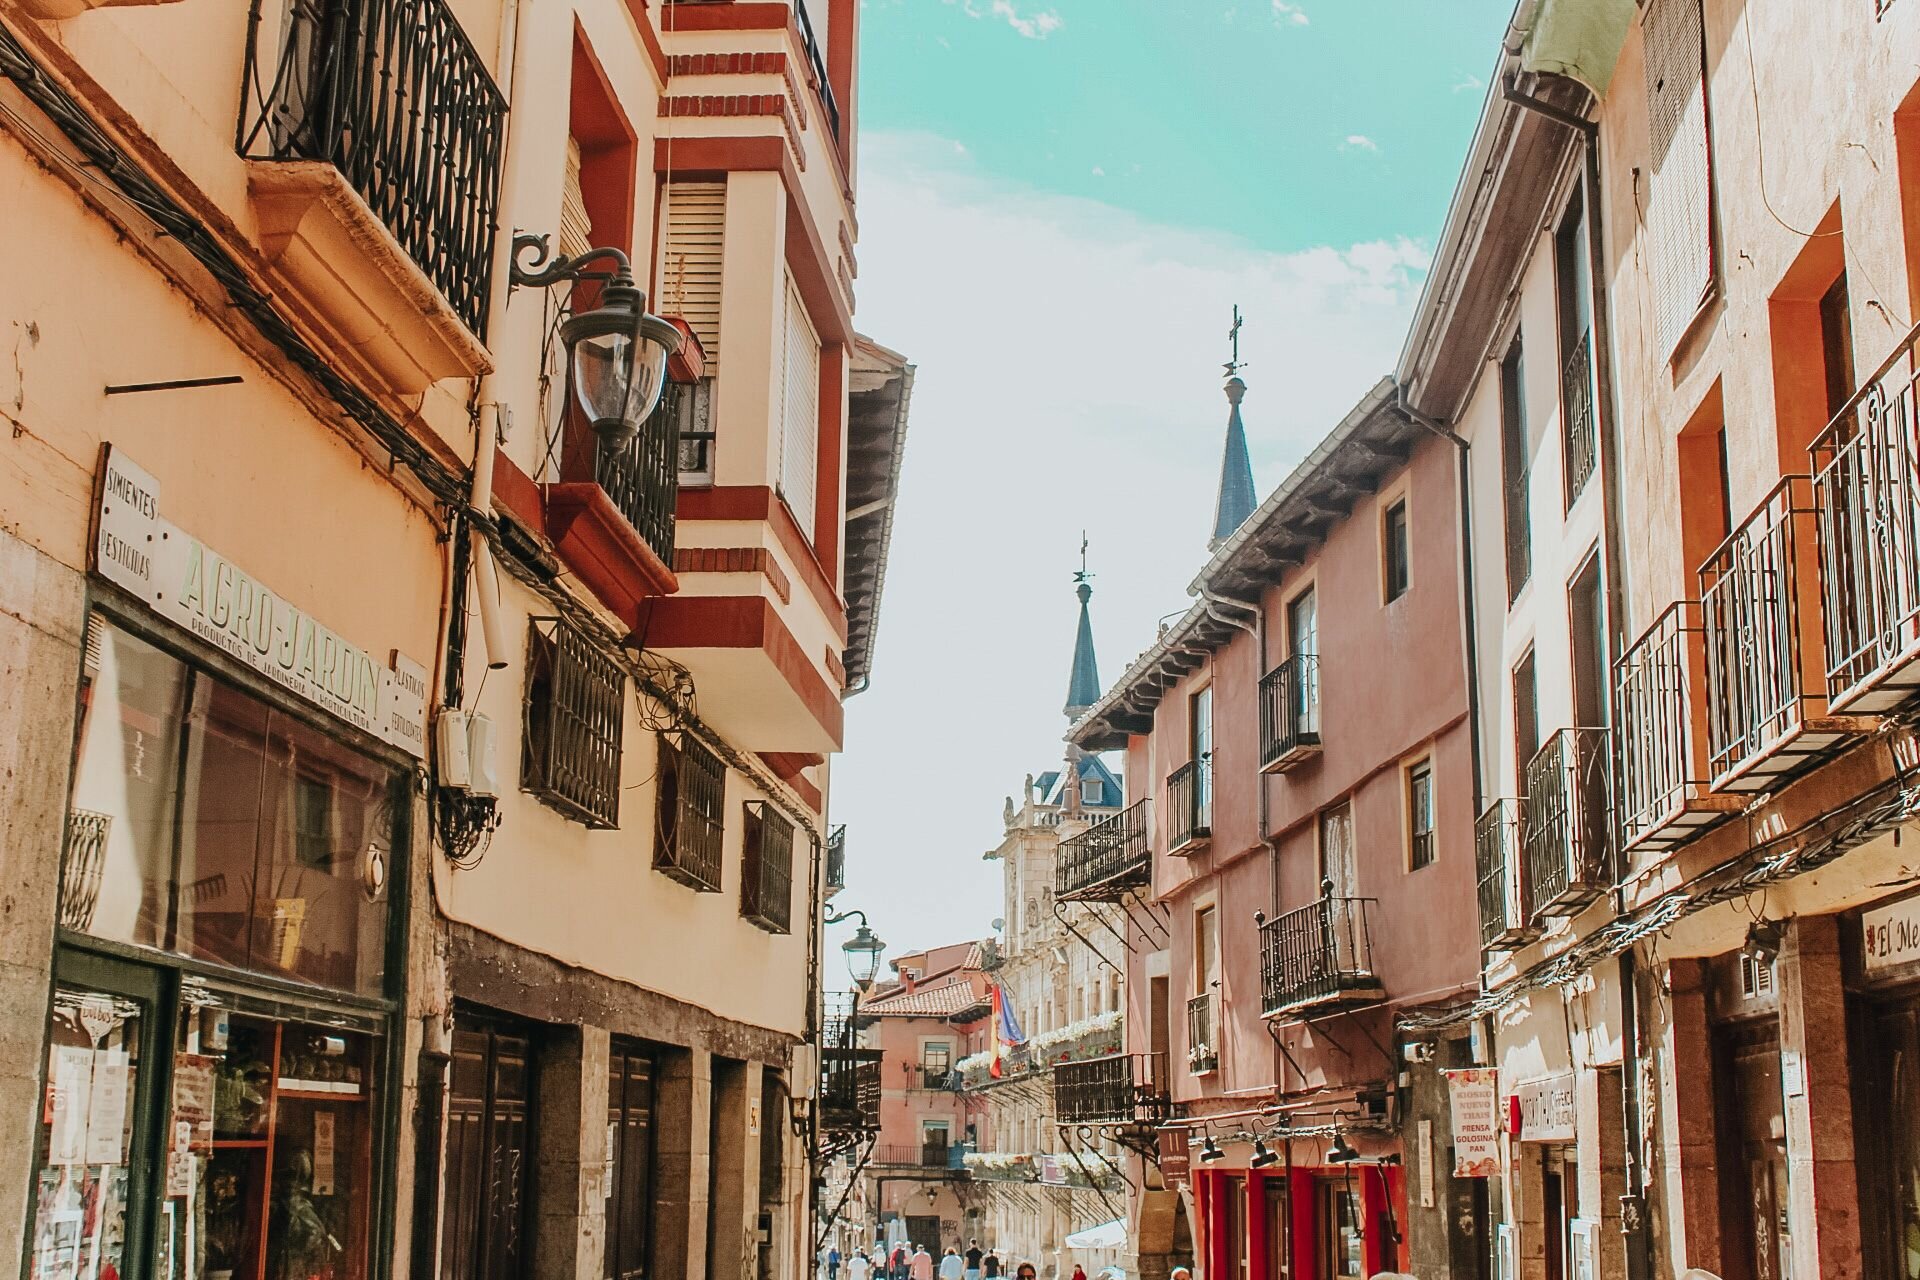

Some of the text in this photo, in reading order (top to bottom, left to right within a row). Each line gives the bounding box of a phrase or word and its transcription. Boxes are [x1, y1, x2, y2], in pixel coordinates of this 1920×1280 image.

[107, 467, 156, 520] SIMIENTES
[100, 529, 150, 581] PESTICIDAS
[191, 618, 242, 658] PRODUCTOS
[247, 651, 257, 666] DE
[392, 711, 422, 744] FERTILIZANTES
[1878, 917, 1893, 957] El
[1457, 1090, 1492, 1098] KIOSKO
[1460, 1101, 1491, 1110] NUEVO
[1463, 1111, 1490, 1120] THAIS
[1462, 1124, 1490, 1132] PRENSA
[1469, 1145, 1486, 1153] PAN
